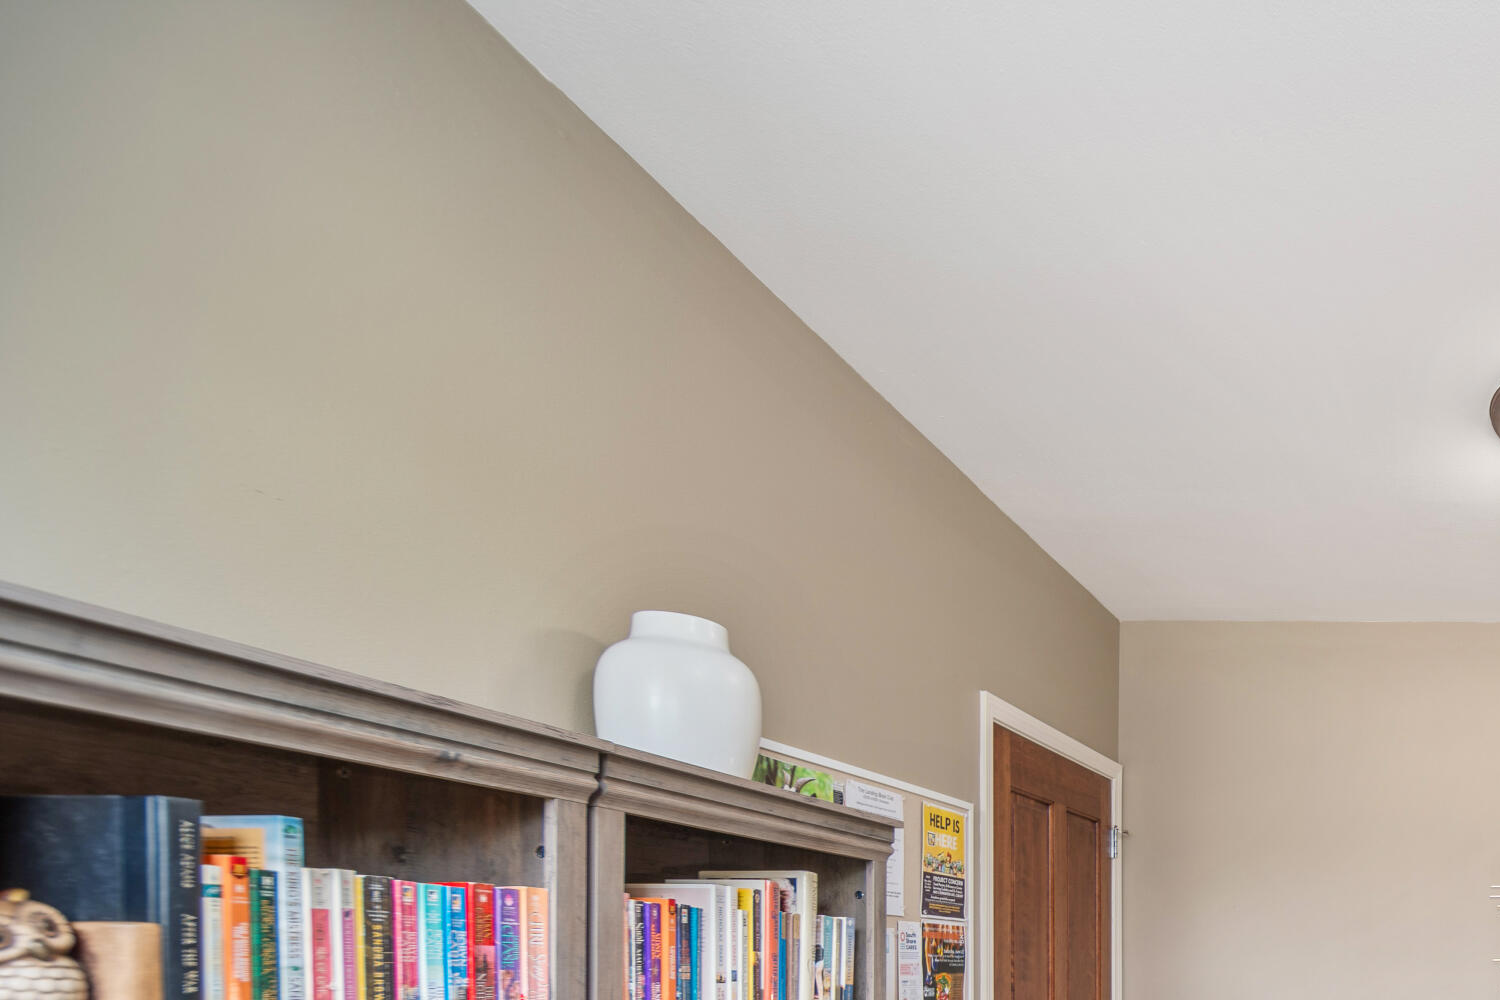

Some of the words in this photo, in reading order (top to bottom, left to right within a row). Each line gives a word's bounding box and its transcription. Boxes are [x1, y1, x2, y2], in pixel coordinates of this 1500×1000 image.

[929, 812, 951, 831] HELP
[953, 819, 960, 834] IS
[934, 833, 958, 850] HERE
[371, 924, 385, 967] SANDRA
